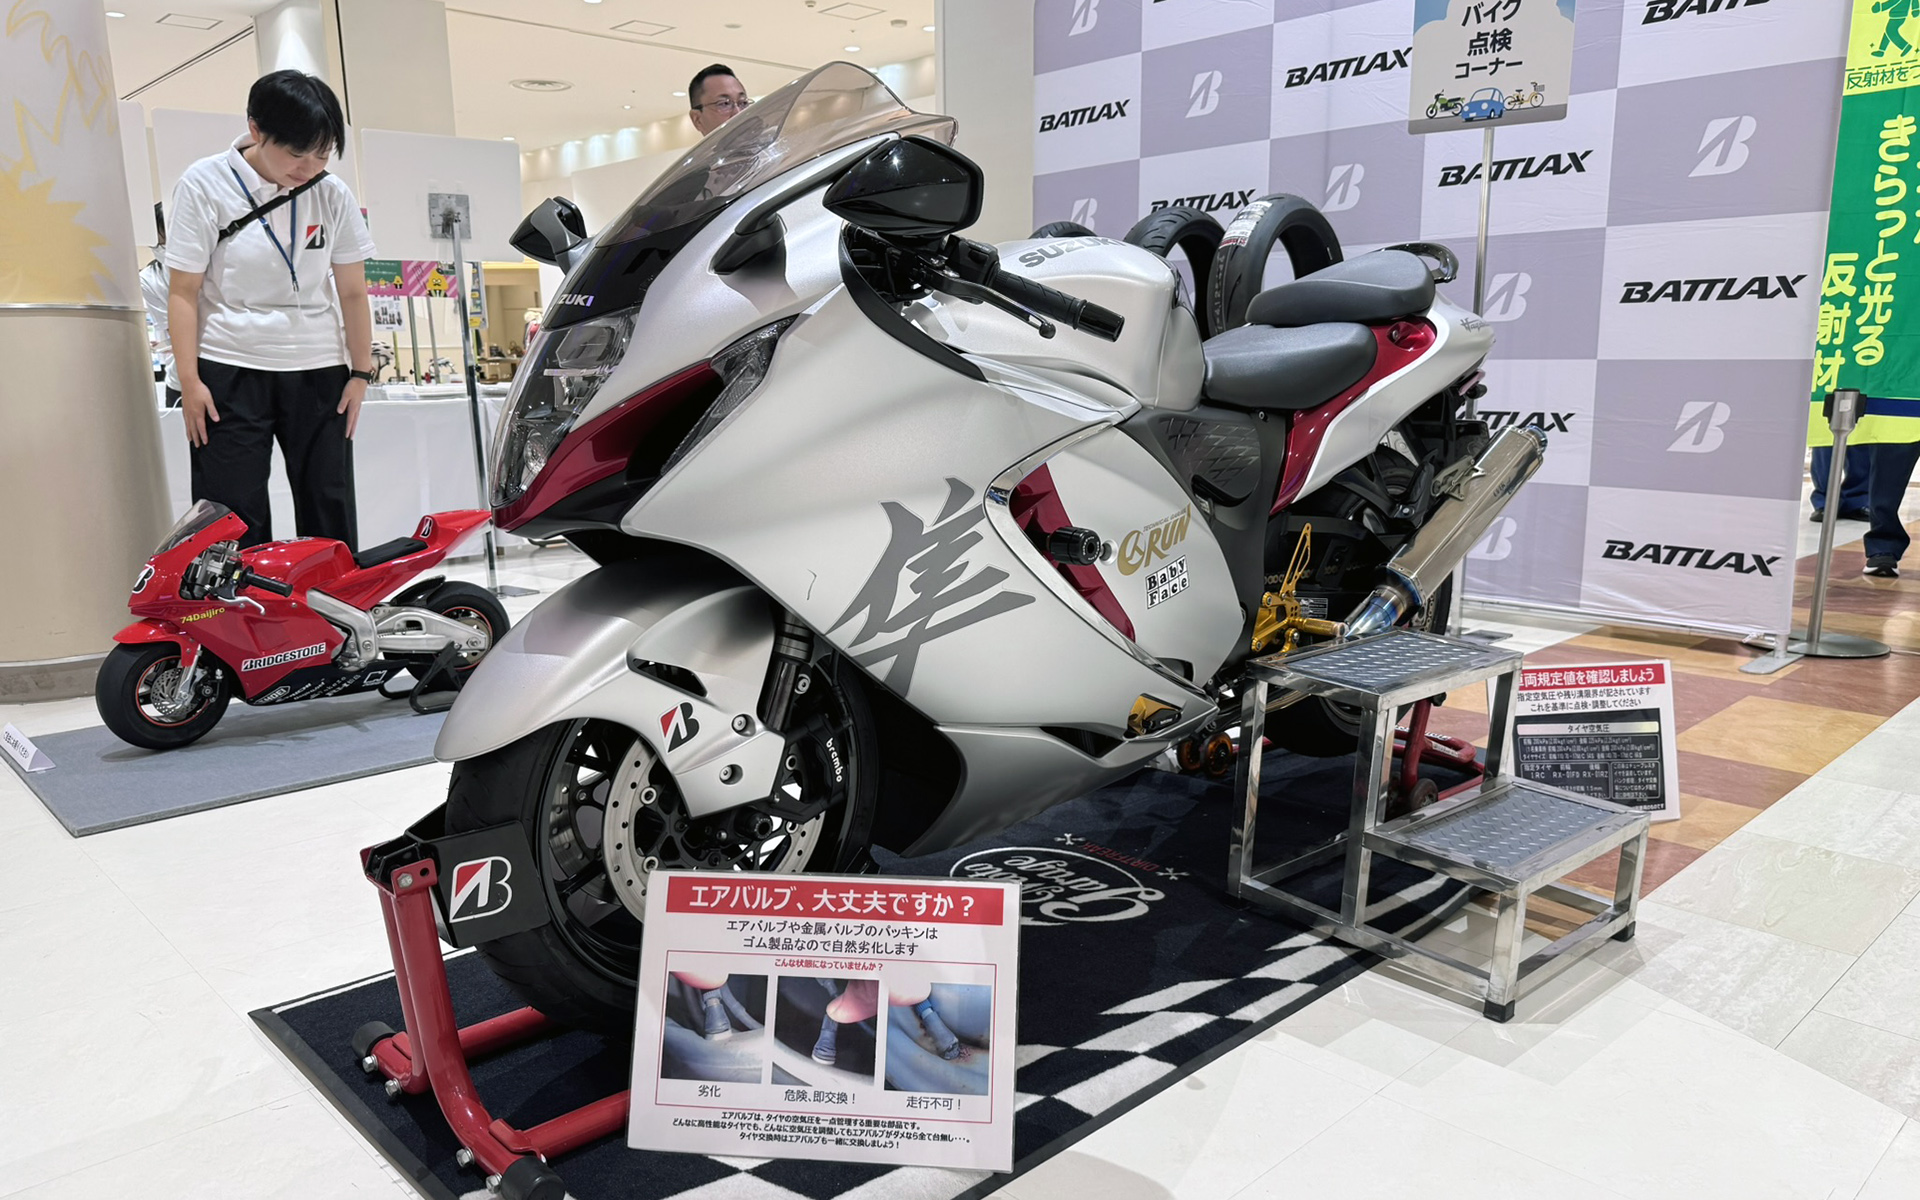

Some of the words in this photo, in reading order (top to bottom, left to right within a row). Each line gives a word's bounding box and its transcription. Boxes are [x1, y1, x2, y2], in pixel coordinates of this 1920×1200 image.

[1461, 0, 1522, 27] バイク
[1467, 28, 1513, 57] 点検
[1283, 46, 1413, 89] BATTLAX
[1454, 57, 1523, 79] コーナー
[1039, 98, 1131, 134] BATTLAX
[1438, 149, 1594, 188] BATTLAX
[1018, 235, 1126, 268] SUZUKI
[1852, 113, 1918, 367] きらっと光る
[1619, 274, 1808, 304] BATTLAX
[1810, 252, 1860, 393] 反射材
[1601, 538, 1782, 578] BATTLAX
[1147, 558, 1186, 591] Baby
[1149, 577, 1188, 607] Face
[180, 607, 226, 624] 74Daijiro
[242, 643, 326, 671] BRIDGESTONE
[1530, 699, 1642, 713] これを基準に点検・調整してください
[1567, 723, 1610, 733] タイヤ空気圧
[825, 737, 844, 783] brembo
[688, 884, 976, 918] エアバルブ、大丈夫ですか？
[726, 919, 939, 940] エアバルブや金属バルブのパッキンは
[743, 937, 919, 957] ゴム製品なので自然劣化します
[774, 958, 884, 972] こんな状態になっていませんか？
[698, 1084, 721, 1098] 劣化
[784, 1089, 857, 1105] 危険、即交換！
[906, 1096, 962, 1110] 走行不可！
[721, 1111, 921, 1131] エアバルブは、タイヤの空気圧を一点管理する重要な部品です。
[739, 1132, 900, 1149] タイヤ交換時はエアバルブも一緒に交換しましょう！
